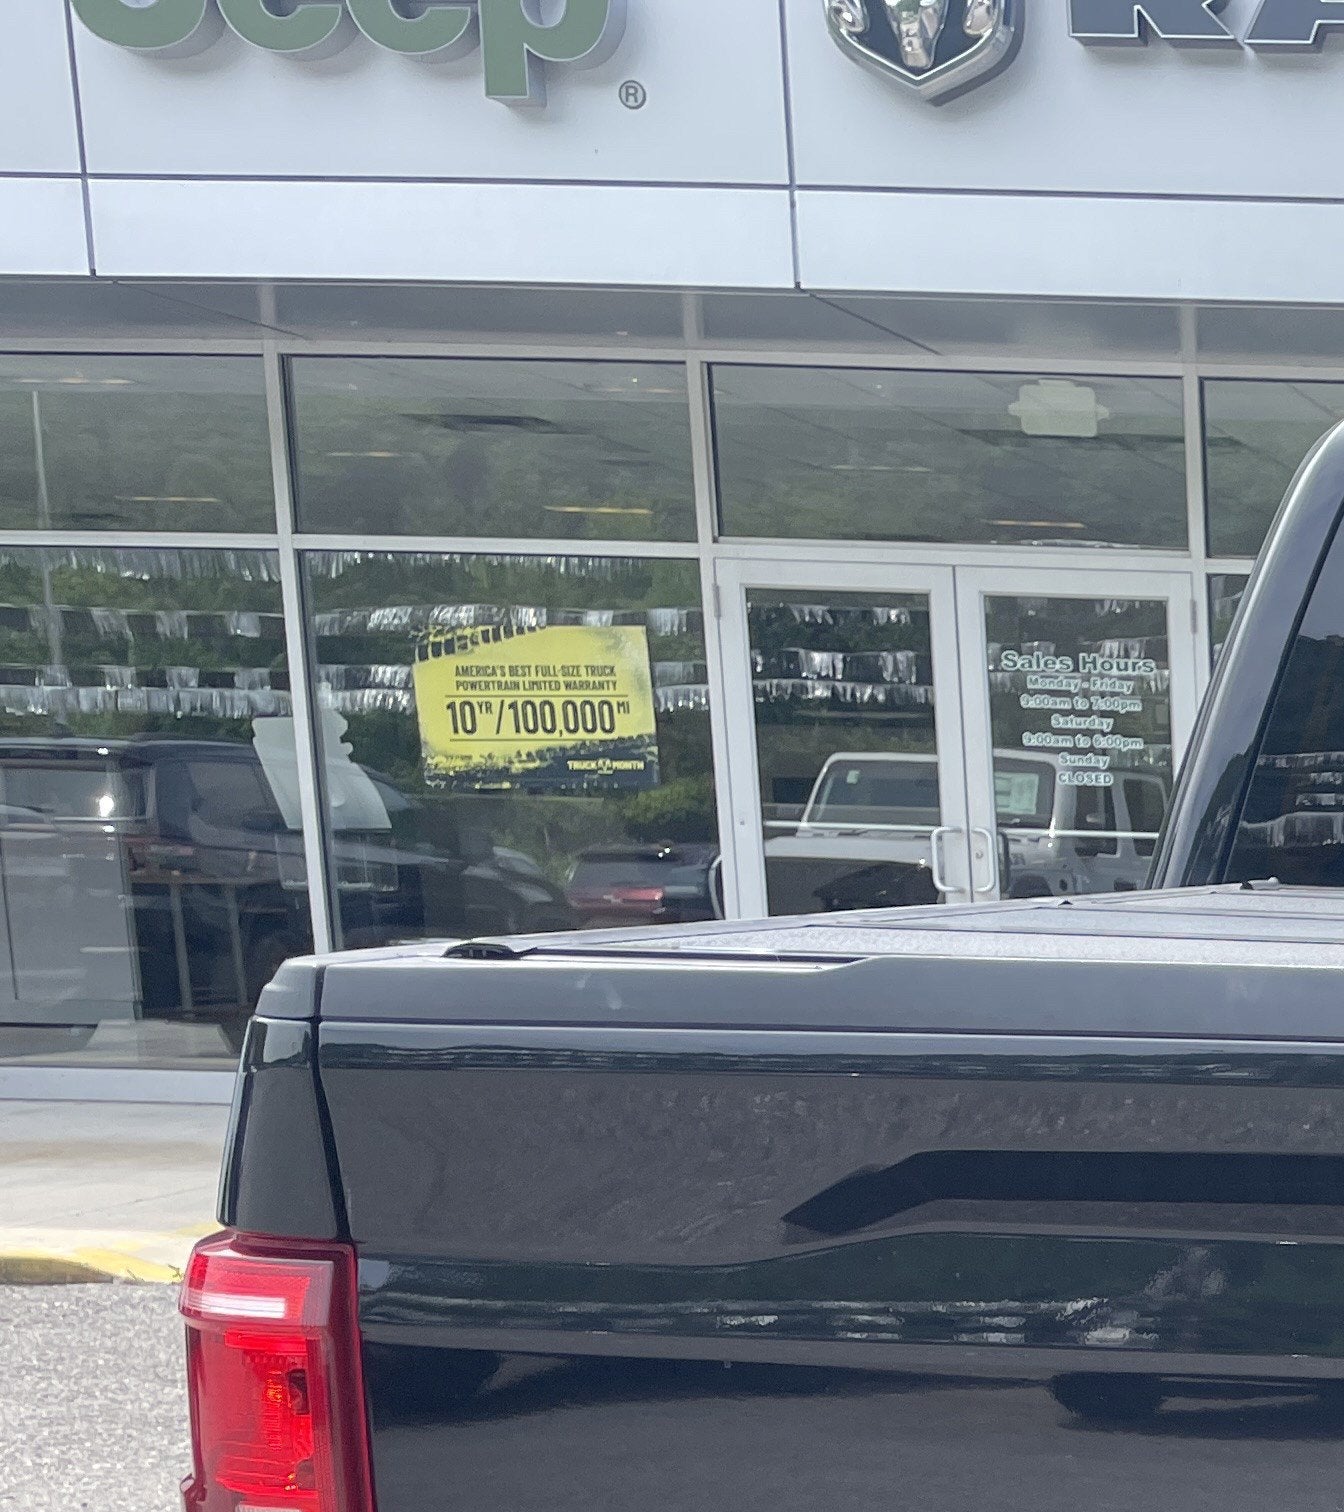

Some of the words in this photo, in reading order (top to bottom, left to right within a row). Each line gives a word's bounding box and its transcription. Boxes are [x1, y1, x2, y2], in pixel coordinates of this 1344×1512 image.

[455, 665, 506, 677] AMERICA'S
[508, 665, 532, 677] BEST
[535, 665, 581, 677] FULL-SIZE
[584, 665, 616, 677] TRUCK
[1001, 650, 1074, 673] Sales
[1079, 652, 1157, 675] Hours
[456, 680, 520, 691] POWERTRAIN
[522, 680, 561, 691] LIMITED
[564, 680, 617, 691] WARRANTY
[1026, 675, 1080, 693] Monday
[1090, 676, 1135, 695] Friday
[1073, 695, 1090, 710] to
[1090, 695, 1142, 714] 7:00pm
[1051, 713, 1114, 732] Saturday
[1075, 733, 1091, 748] to
[1058, 751, 1110, 769] Sunday
[1058, 771, 1114, 787] CLOSED
